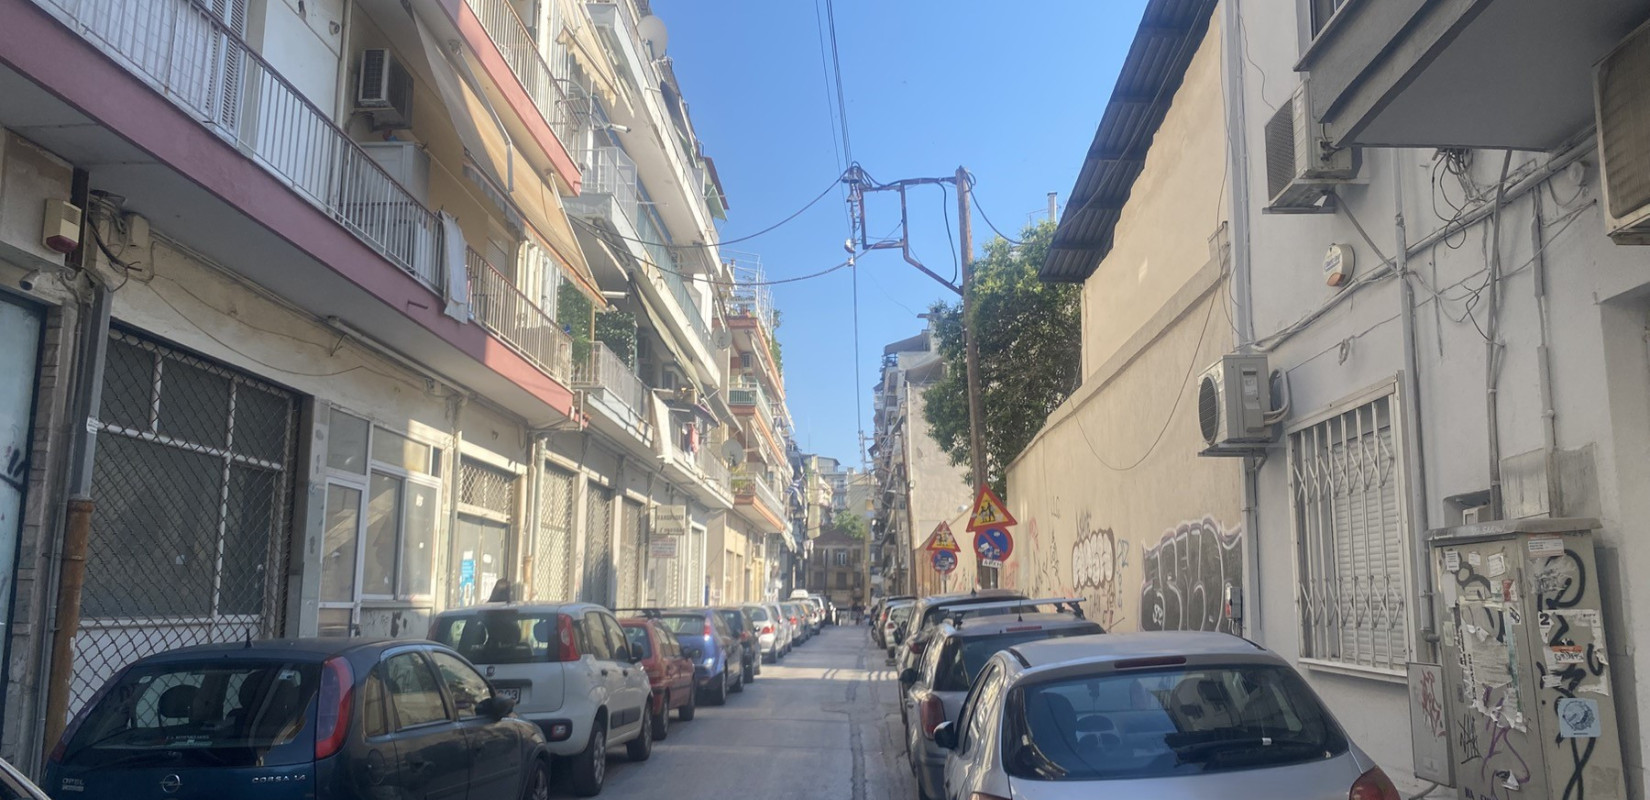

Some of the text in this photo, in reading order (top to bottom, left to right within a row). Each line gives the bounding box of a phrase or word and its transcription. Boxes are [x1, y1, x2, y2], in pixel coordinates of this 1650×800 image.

[1539, 613, 1550, 626] 2
[62, 777, 85, 785] OPEL
[252, 775, 290, 784] CORSA
